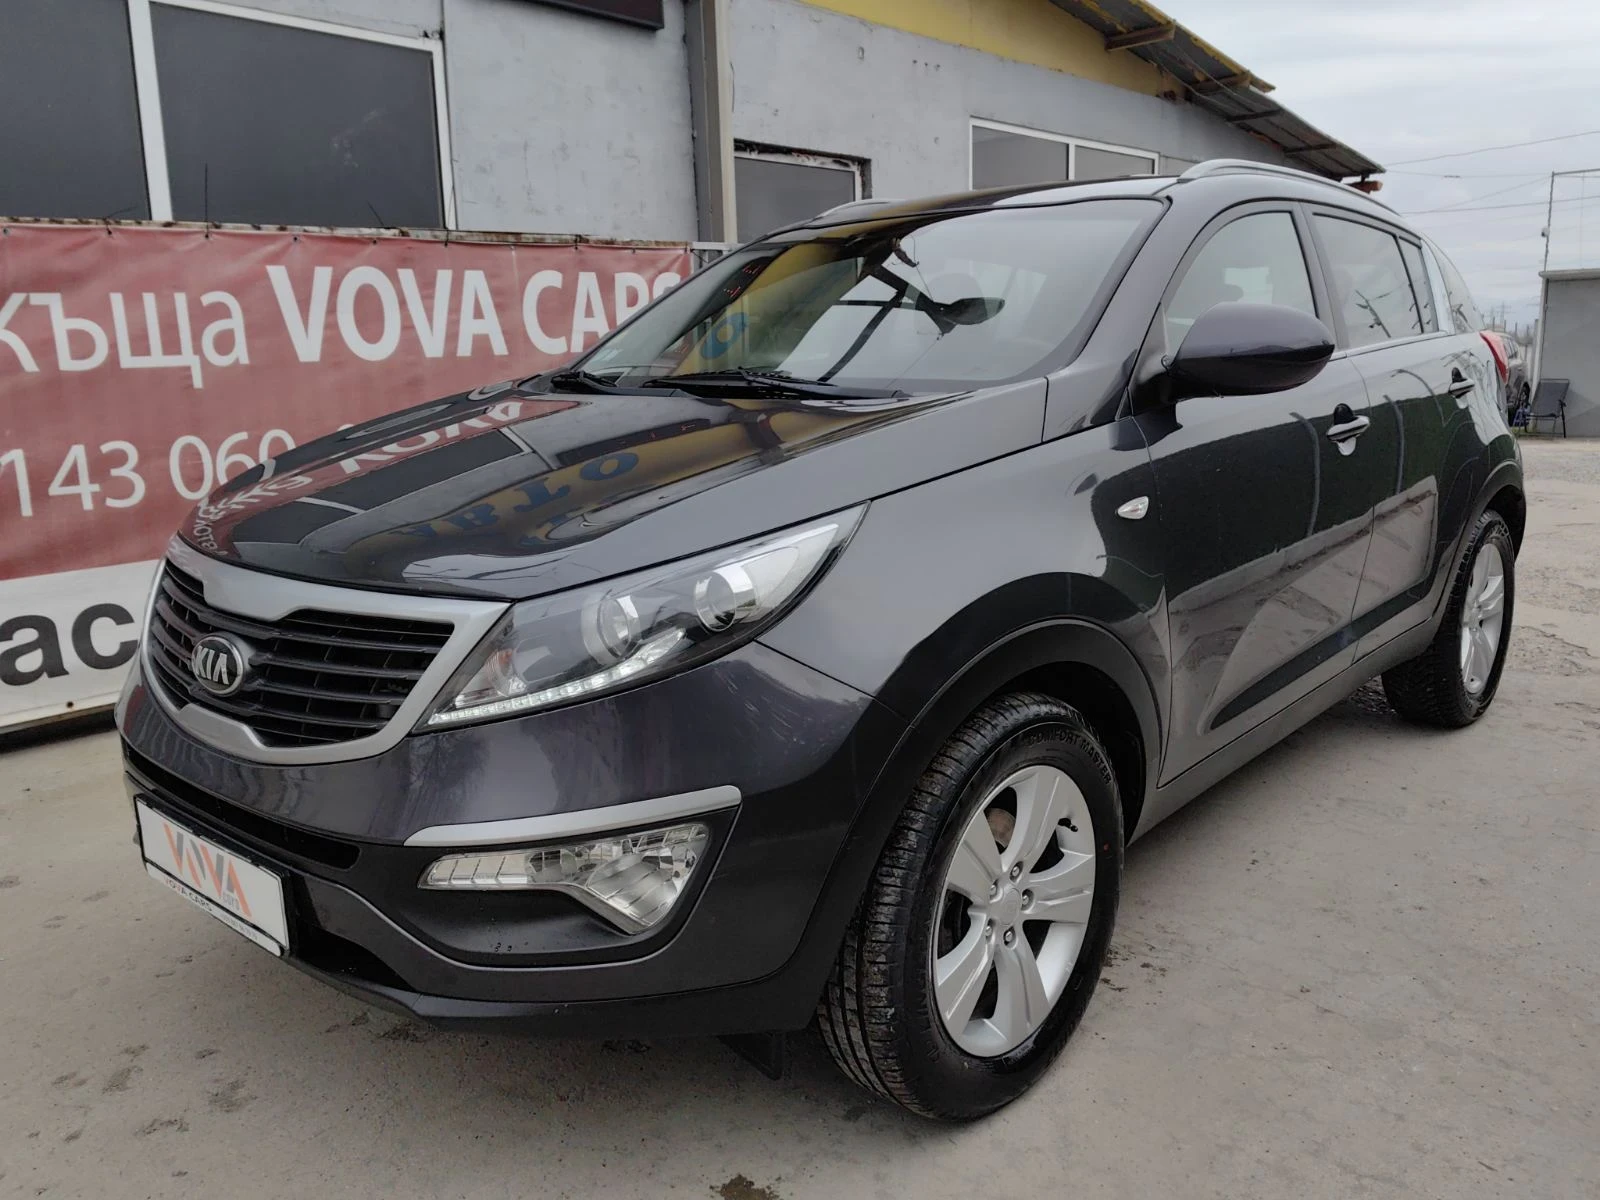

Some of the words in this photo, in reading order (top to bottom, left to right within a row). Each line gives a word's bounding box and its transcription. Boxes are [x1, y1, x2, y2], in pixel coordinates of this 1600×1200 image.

[265, 265, 509, 363] VOVA
[196, 645, 230, 685] KIA
[1080, 739, 1112, 785] MASTER
